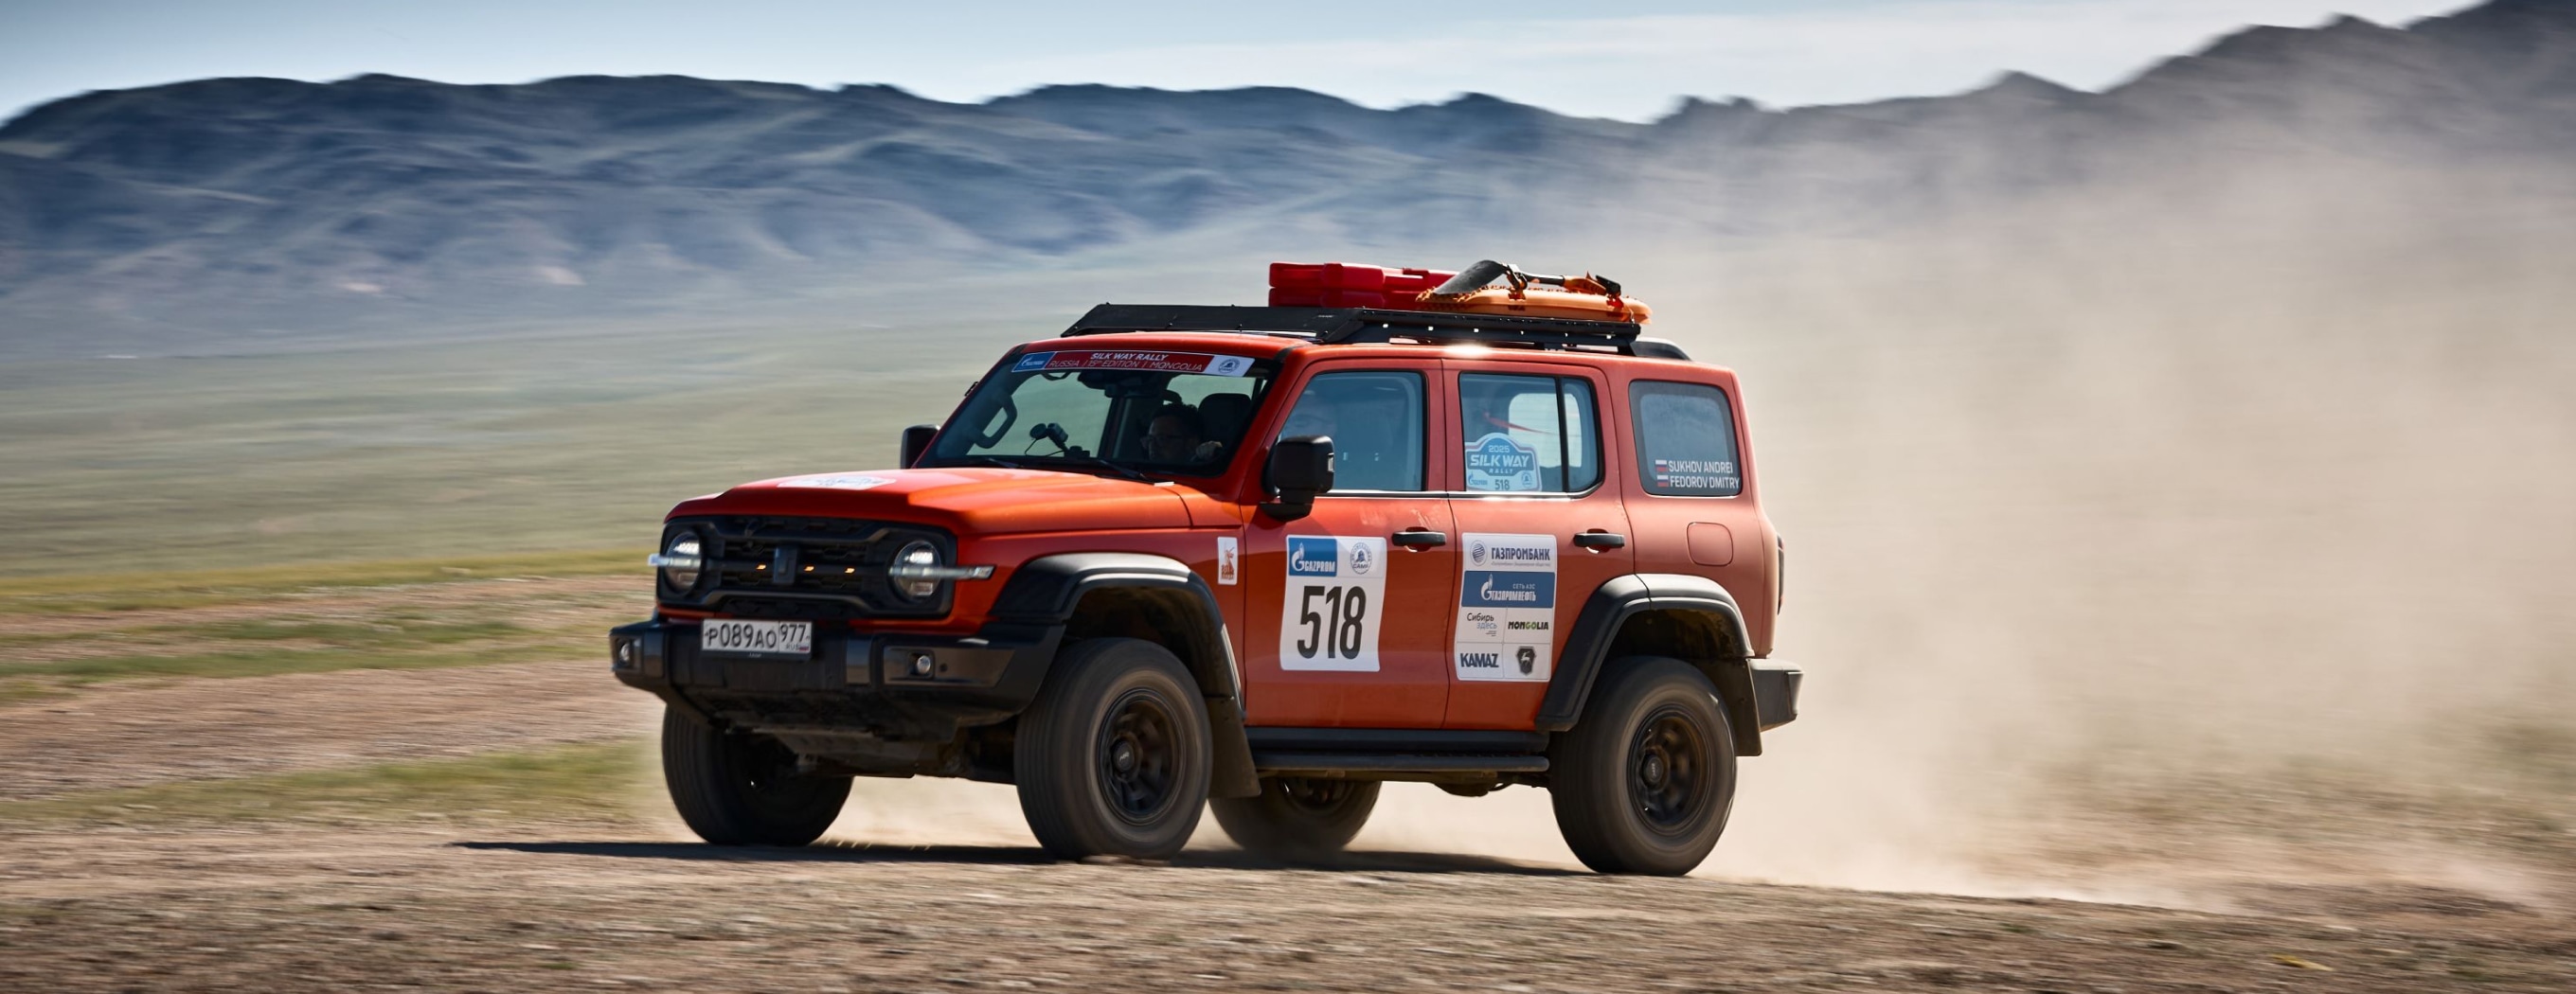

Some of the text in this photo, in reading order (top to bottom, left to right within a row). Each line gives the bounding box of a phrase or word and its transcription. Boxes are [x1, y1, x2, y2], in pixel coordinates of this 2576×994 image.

[1048, 360, 1080, 368] RUSSIA
[1151, 362, 1203, 370] MONGOLIA
[1488, 445, 1511, 453] 2025
[1470, 454, 1530, 468] SILK WAY
[1668, 460, 1733, 474] SUKHOV ANDREI
[1494, 479, 1511, 490] 518
[1670, 475, 1741, 489] FEDOROV DMITRY
[1491, 547, 1551, 561] ГАЗПРОМБАНК
[1491, 590, 1537, 602] ГАЗПРОМНЕФТЬ
[1297, 585, 1367, 660] 518
[1466, 612, 1494, 622] Сибирь
[1476, 622, 1497, 630] здесь
[1508, 621, 1549, 630] MONGOLIA
[779, 623, 807, 643] 977
[1459, 652, 1499, 668] KAMAZ
